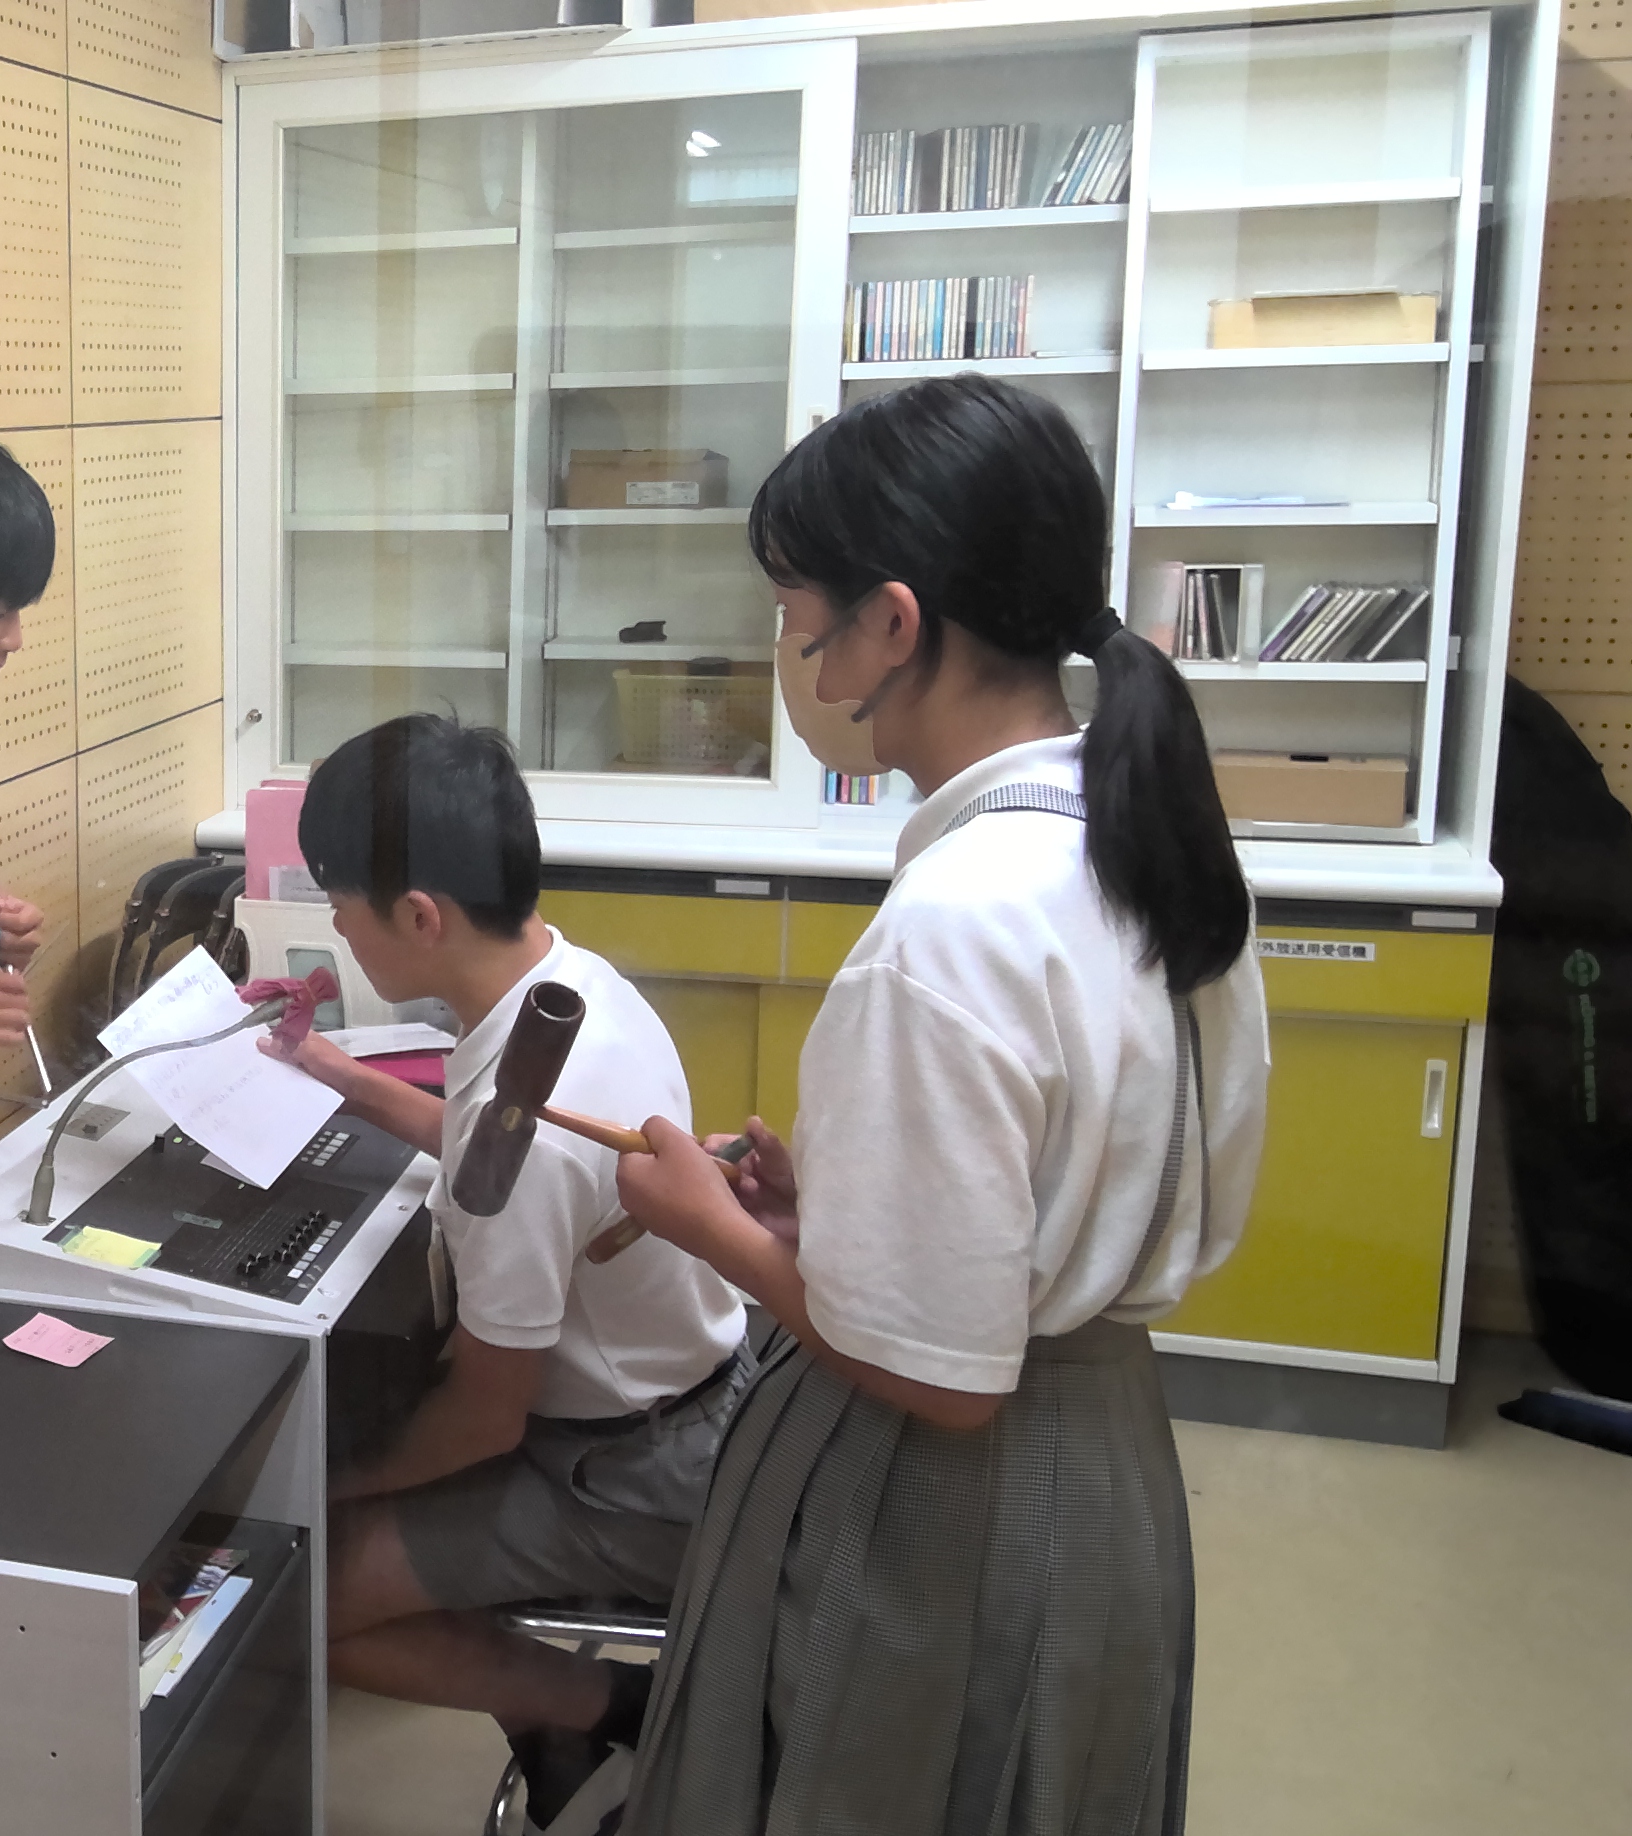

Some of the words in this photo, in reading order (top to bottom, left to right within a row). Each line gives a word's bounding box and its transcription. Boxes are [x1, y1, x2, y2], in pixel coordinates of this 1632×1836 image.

[1256, 941, 1366, 958] 外放送用受信機
